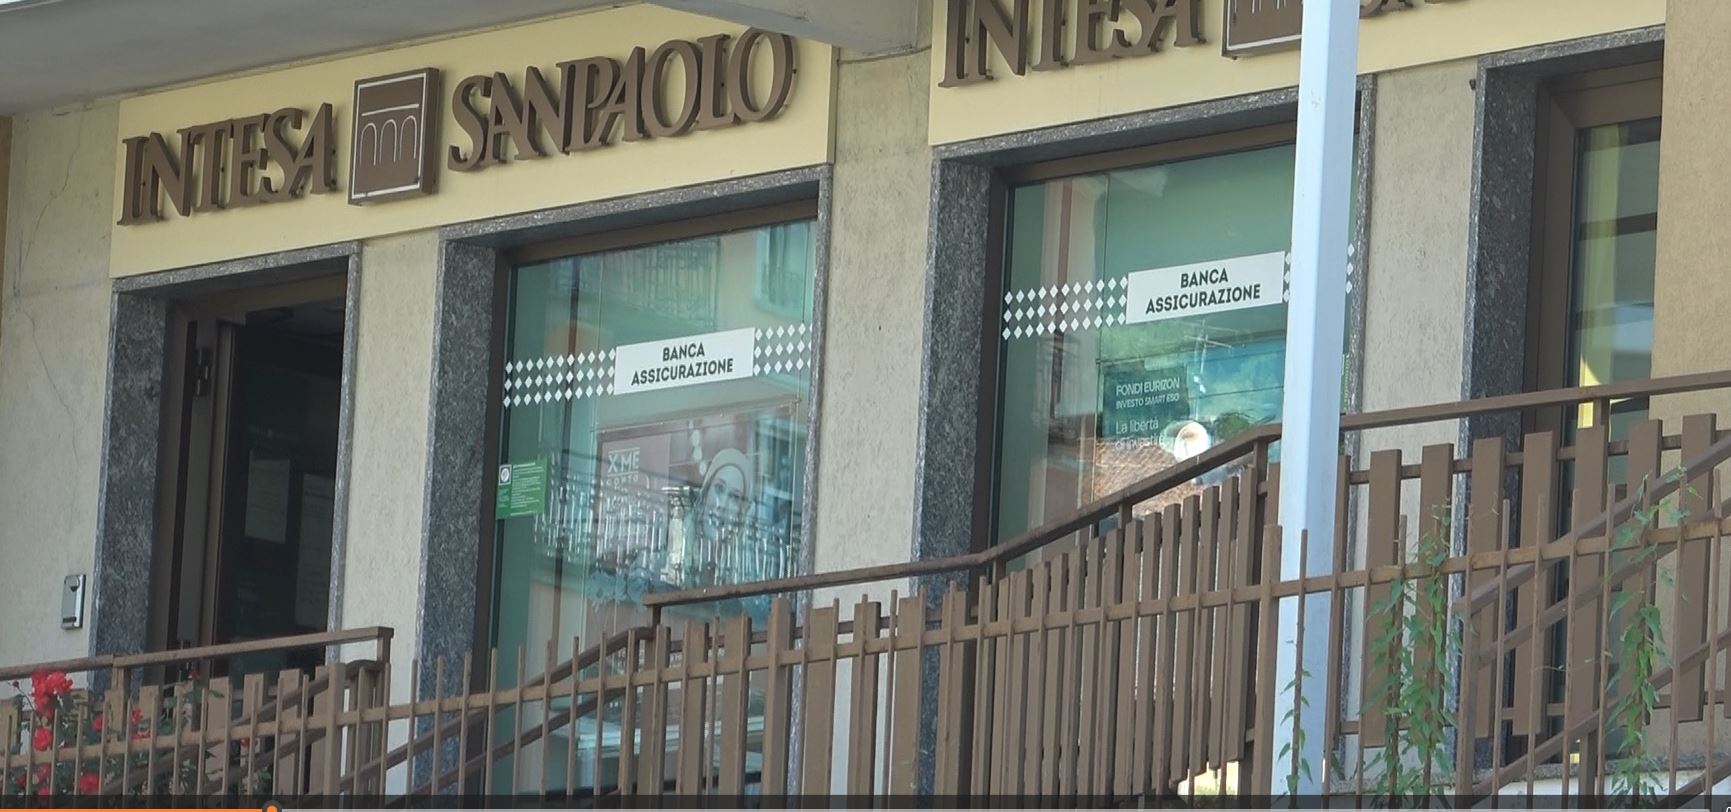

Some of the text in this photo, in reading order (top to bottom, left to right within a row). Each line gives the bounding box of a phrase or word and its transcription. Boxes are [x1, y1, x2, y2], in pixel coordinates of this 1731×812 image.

[117, 27, 798, 225] INTESA SANPAOLO
[1180, 267, 1229, 289] BANCA
[1145, 283, 1262, 315] ASSICURAZIONE
[662, 341, 706, 362] BANCA
[631, 357, 734, 386] ASSICURAZIONE
[1115, 376, 1180, 397] FONDI EURIZON
[1115, 398, 1144, 410] INVESTO
[1115, 420, 1128, 434] La
